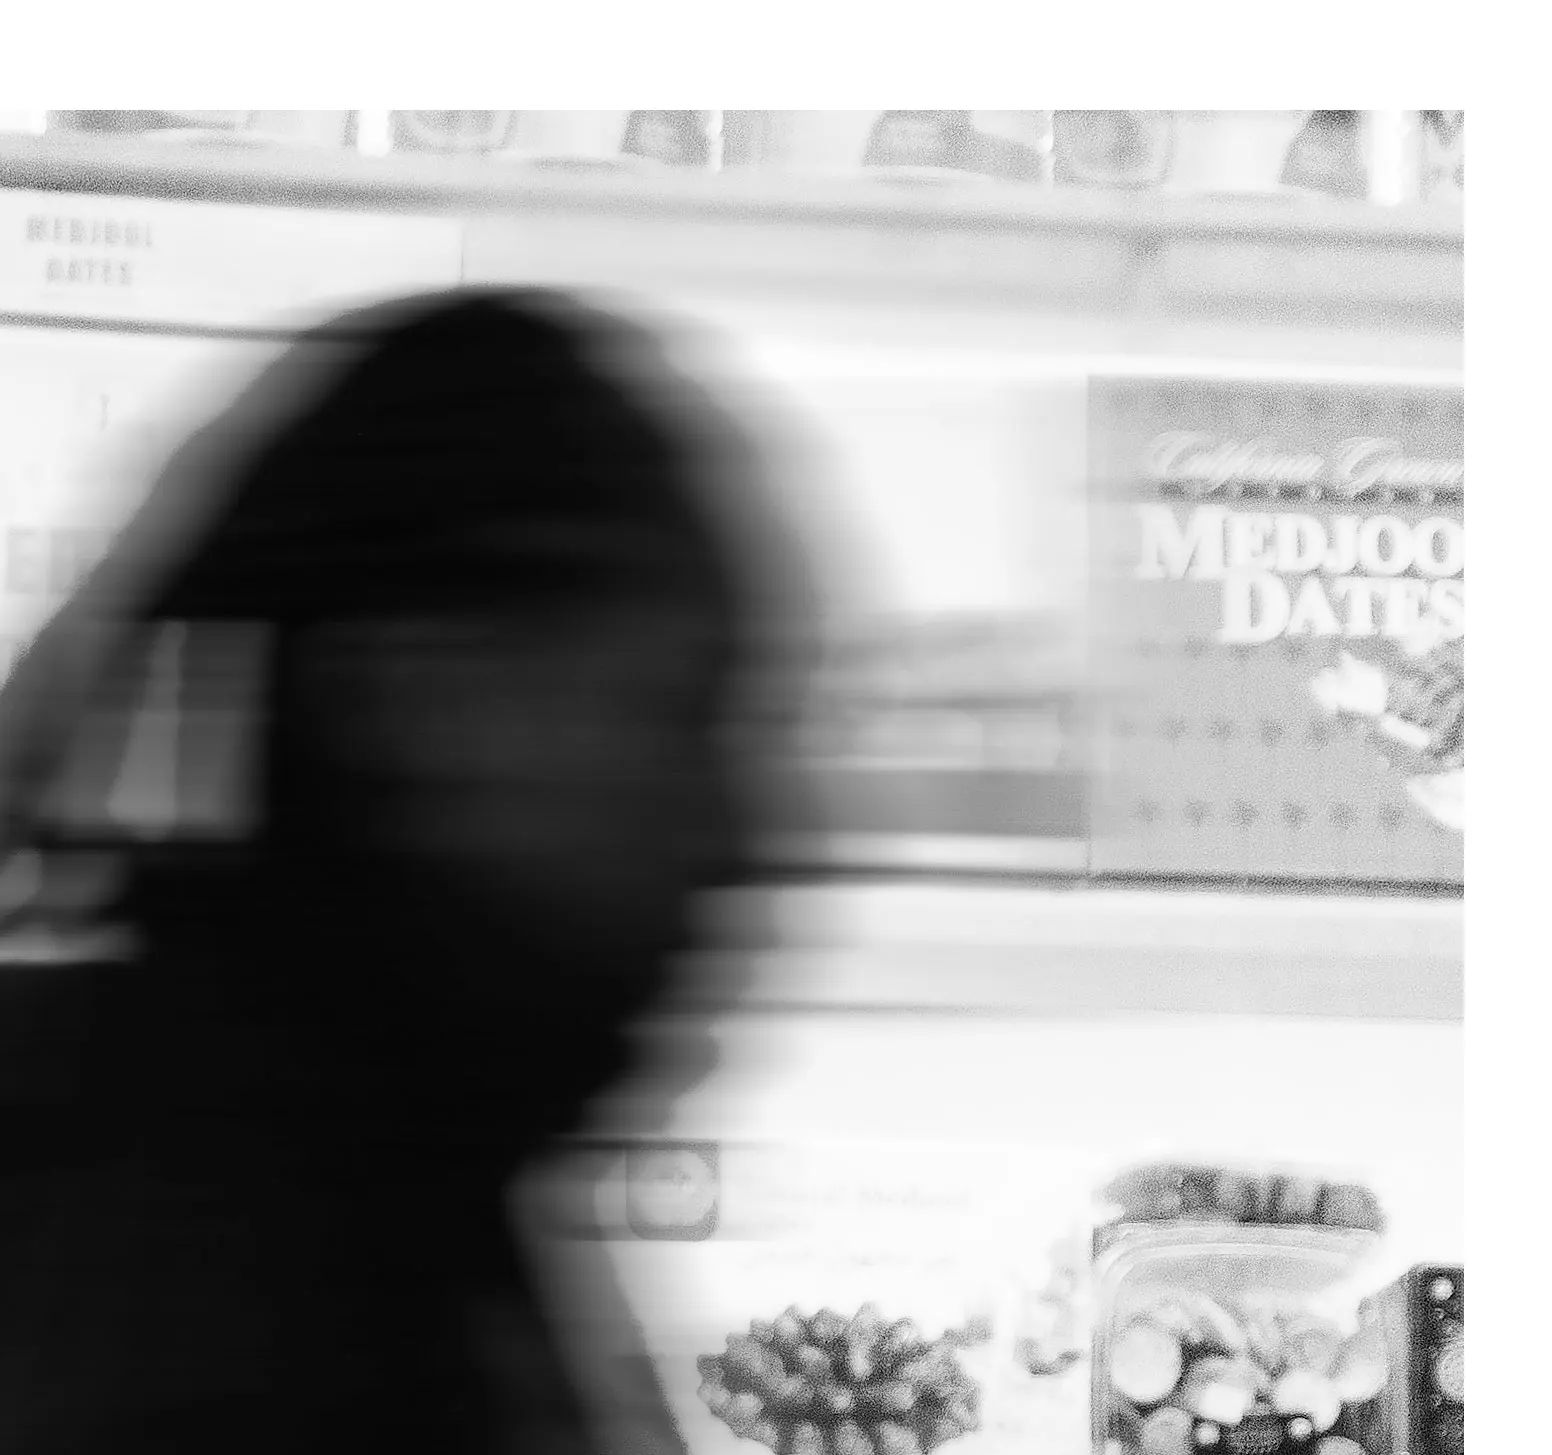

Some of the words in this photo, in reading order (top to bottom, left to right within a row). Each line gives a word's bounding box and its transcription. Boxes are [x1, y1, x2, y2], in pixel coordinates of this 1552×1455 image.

[26, 216, 153, 248] MEDJOOL
[46, 258, 132, 287] DATES
[1218, 569, 1465, 645] DATES
